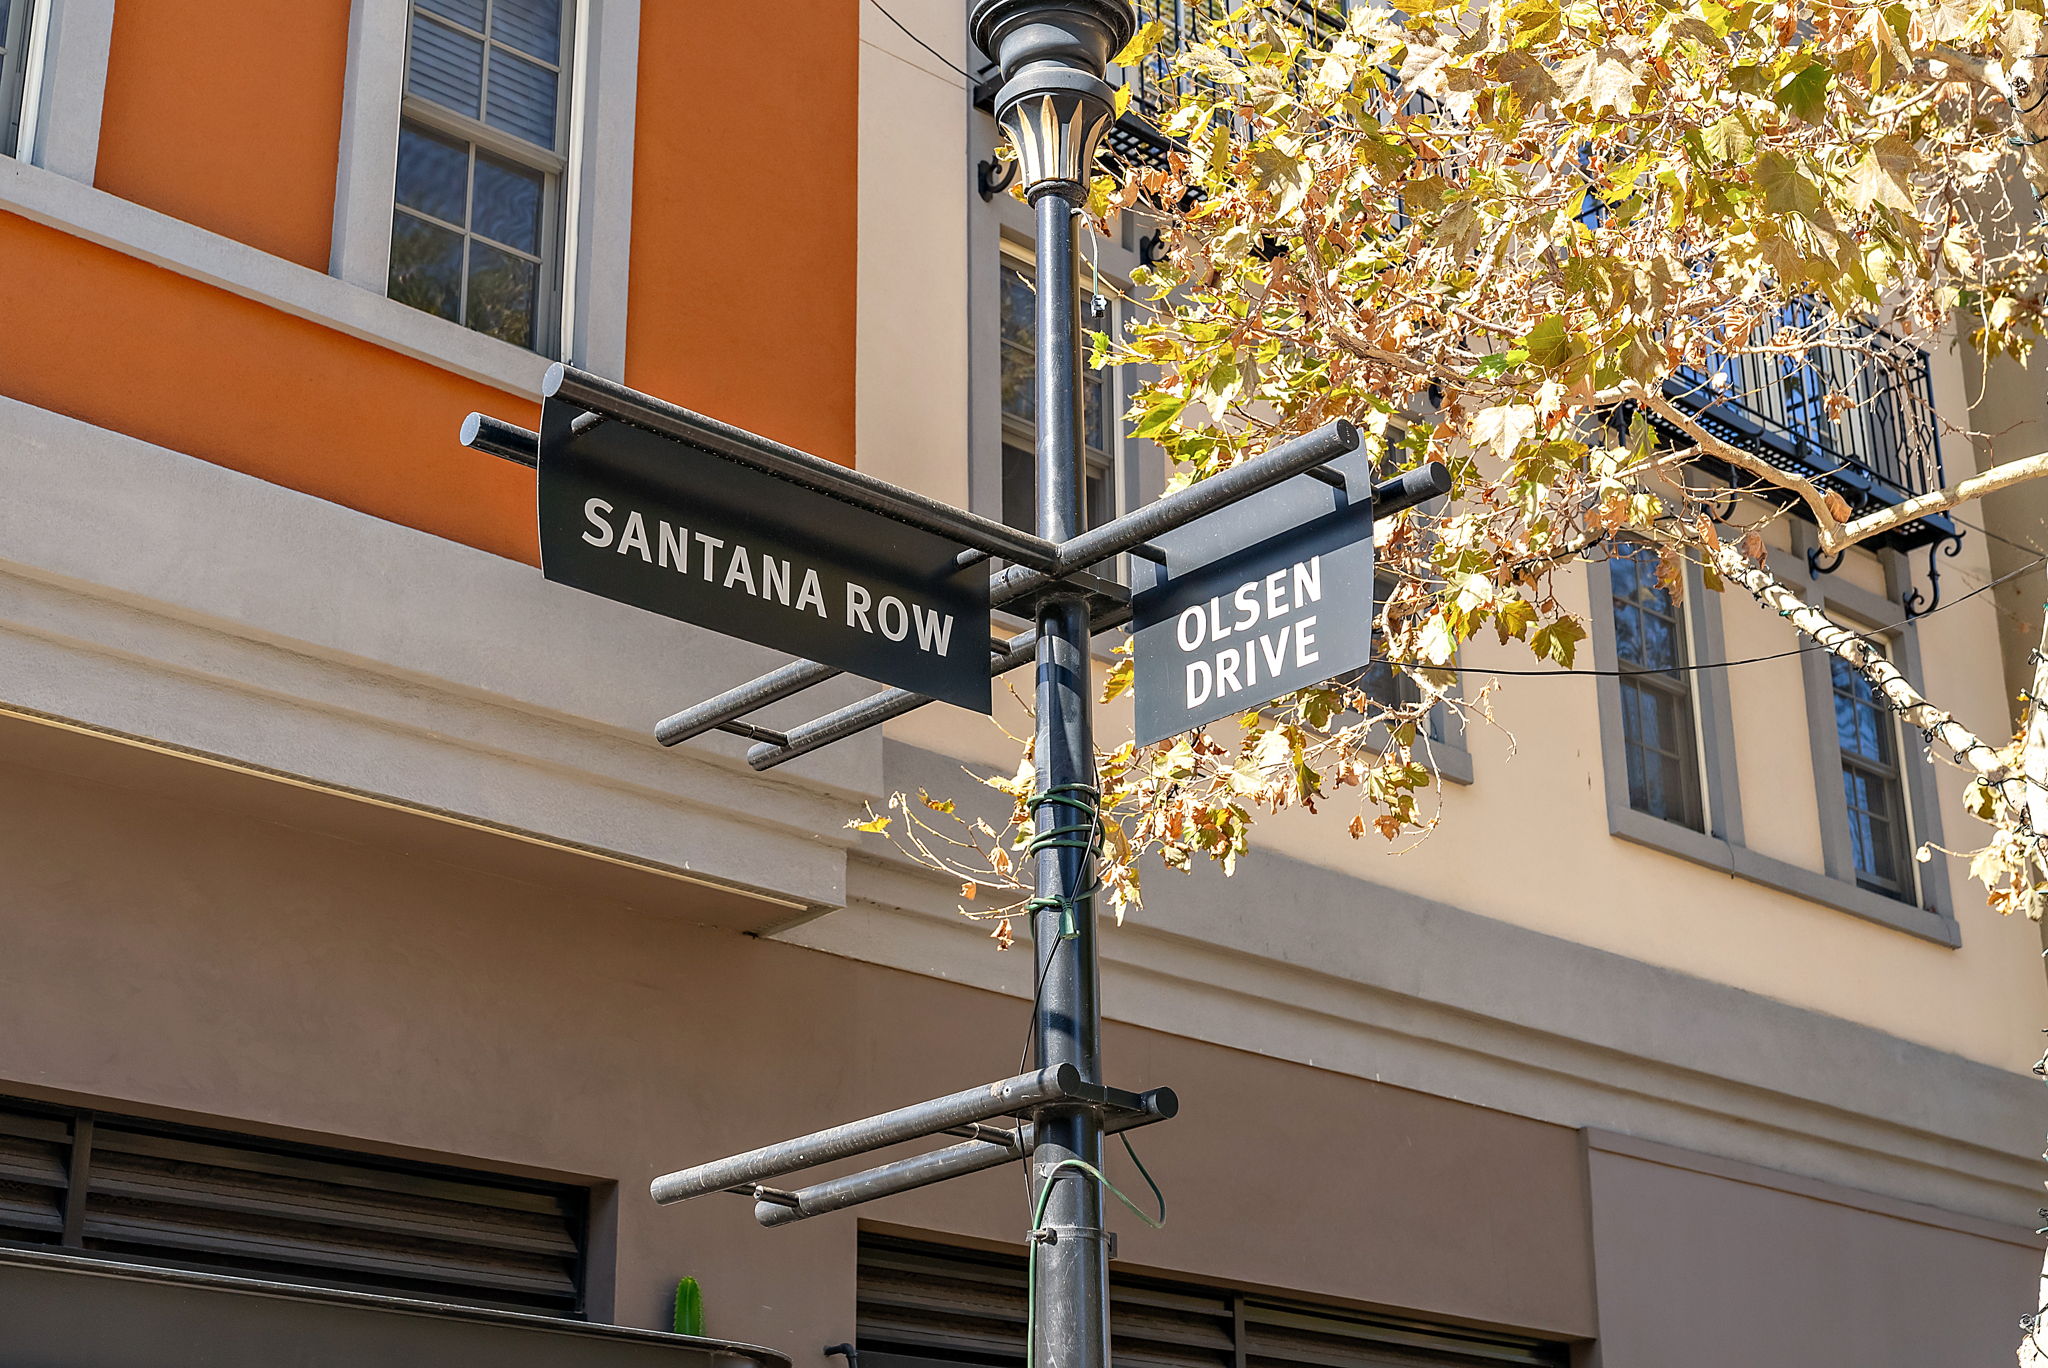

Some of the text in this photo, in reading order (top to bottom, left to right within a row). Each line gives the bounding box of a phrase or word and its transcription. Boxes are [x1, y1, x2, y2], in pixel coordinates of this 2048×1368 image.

[581, 498, 953, 657] SANTANA ROW
[1177, 555, 1321, 652] OLSEN
[1186, 615, 1319, 709] DRIVE
